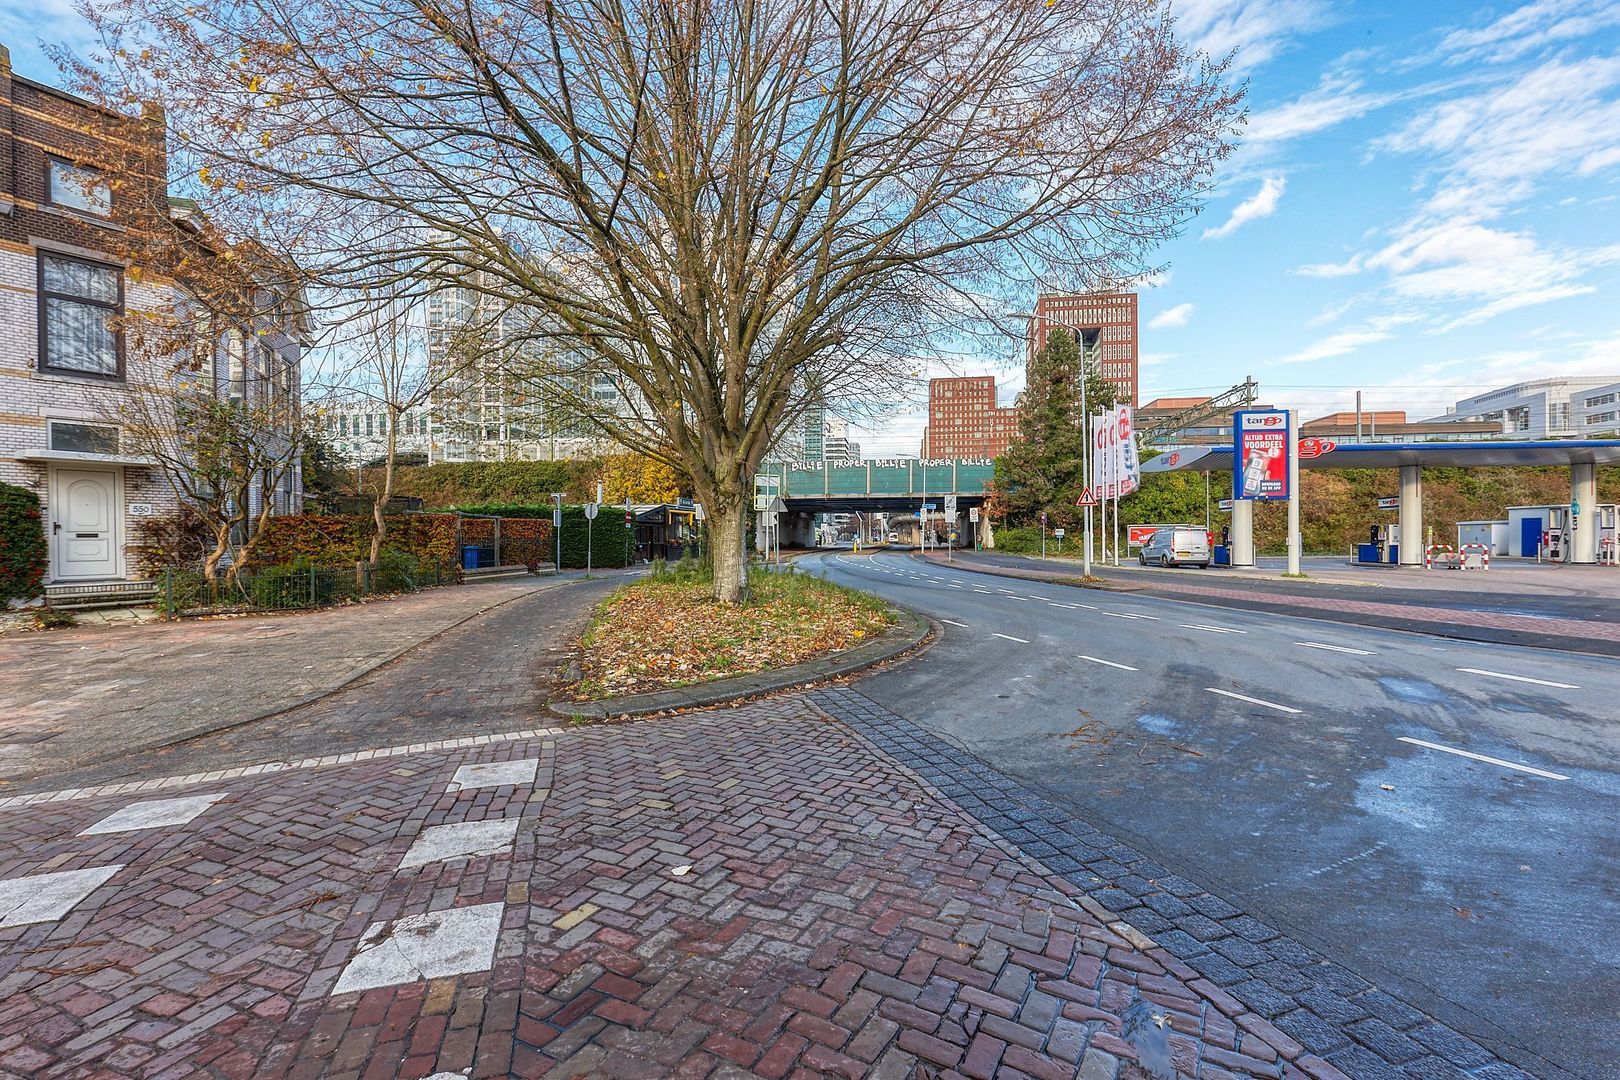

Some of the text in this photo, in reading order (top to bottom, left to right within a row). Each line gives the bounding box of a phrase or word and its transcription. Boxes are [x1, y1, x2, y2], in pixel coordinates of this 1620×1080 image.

[1247, 416, 1283, 426] tango
[1245, 441, 1283, 449] VOORDEEL
[833, 460, 867, 469] PROPER
[918, 459, 955, 467] PROPER
